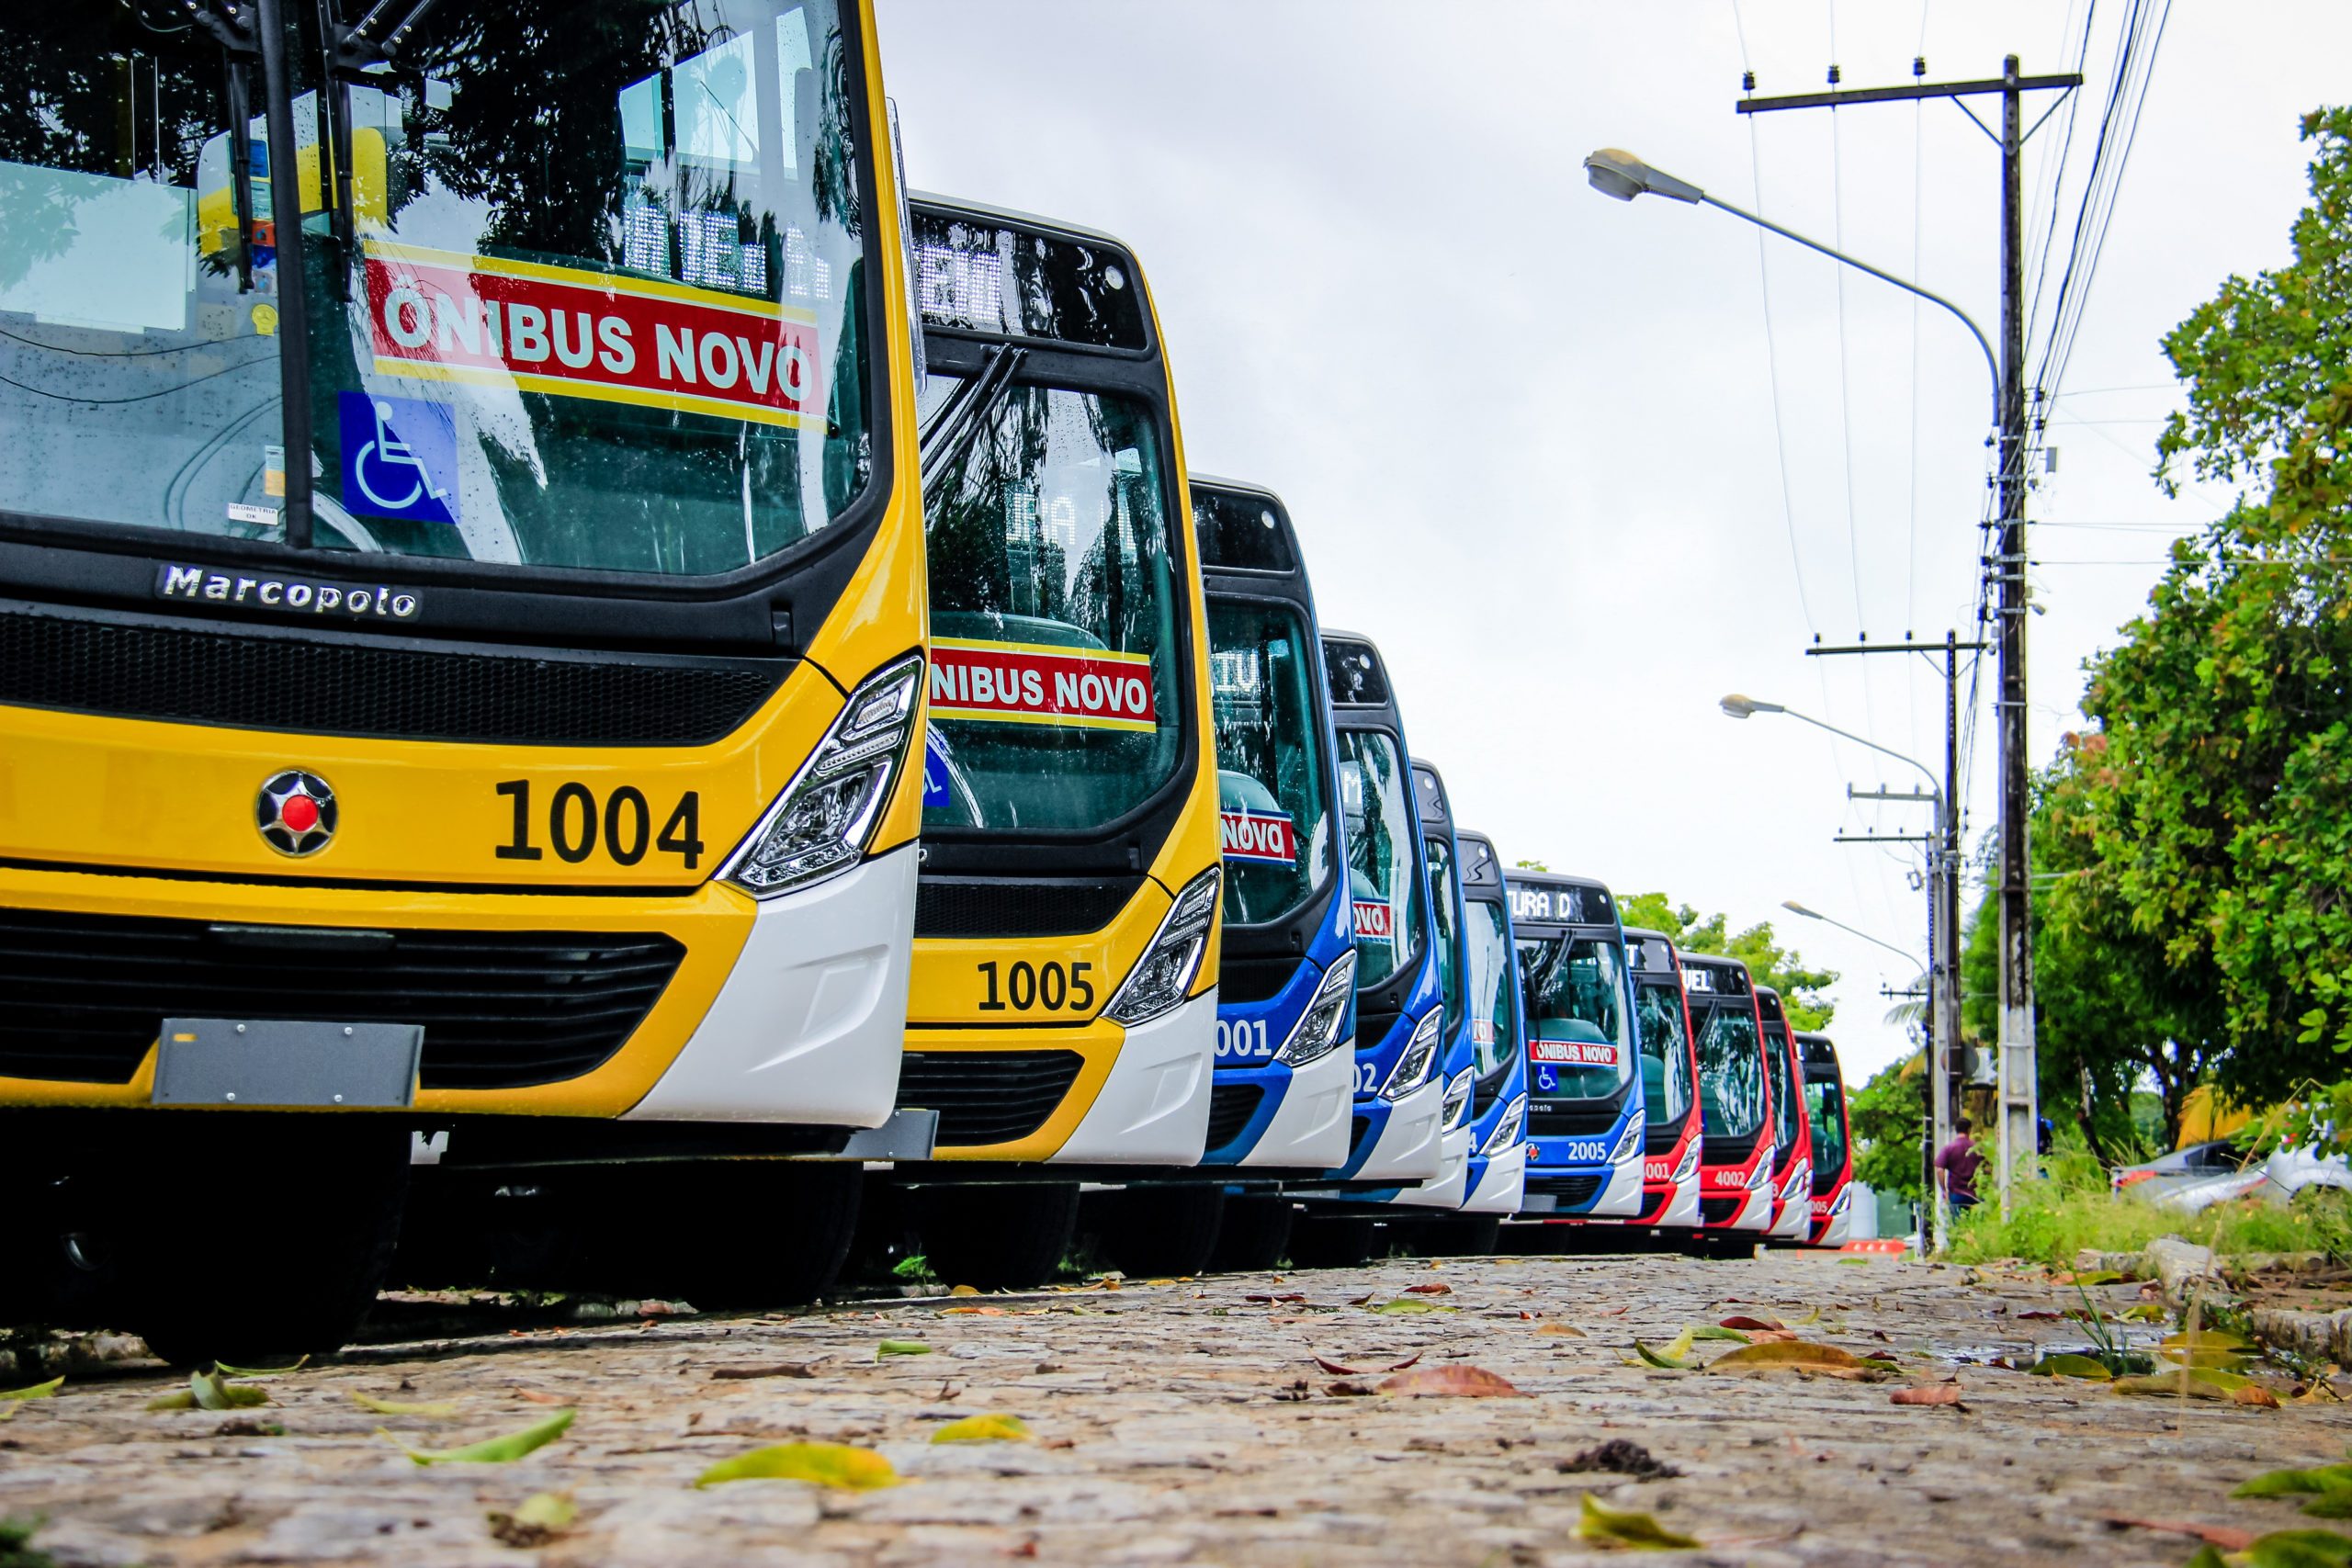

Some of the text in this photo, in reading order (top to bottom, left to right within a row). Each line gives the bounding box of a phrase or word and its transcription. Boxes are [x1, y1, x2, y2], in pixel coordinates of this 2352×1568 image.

[384, 274, 813, 401] ÔNIBUS NOVO
[164, 565, 416, 617] Marcopolo
[930, 663, 1148, 714] NIBUS NOVO
[496, 779, 705, 870] 1004
[1221, 818, 1283, 853] NOVO
[978, 961, 1094, 1011] 1005
[1582, 1045, 1612, 1063] NOVO
[1567, 1142, 1607, 1160] 2005
[1714, 1170, 1746, 1187] 4002
